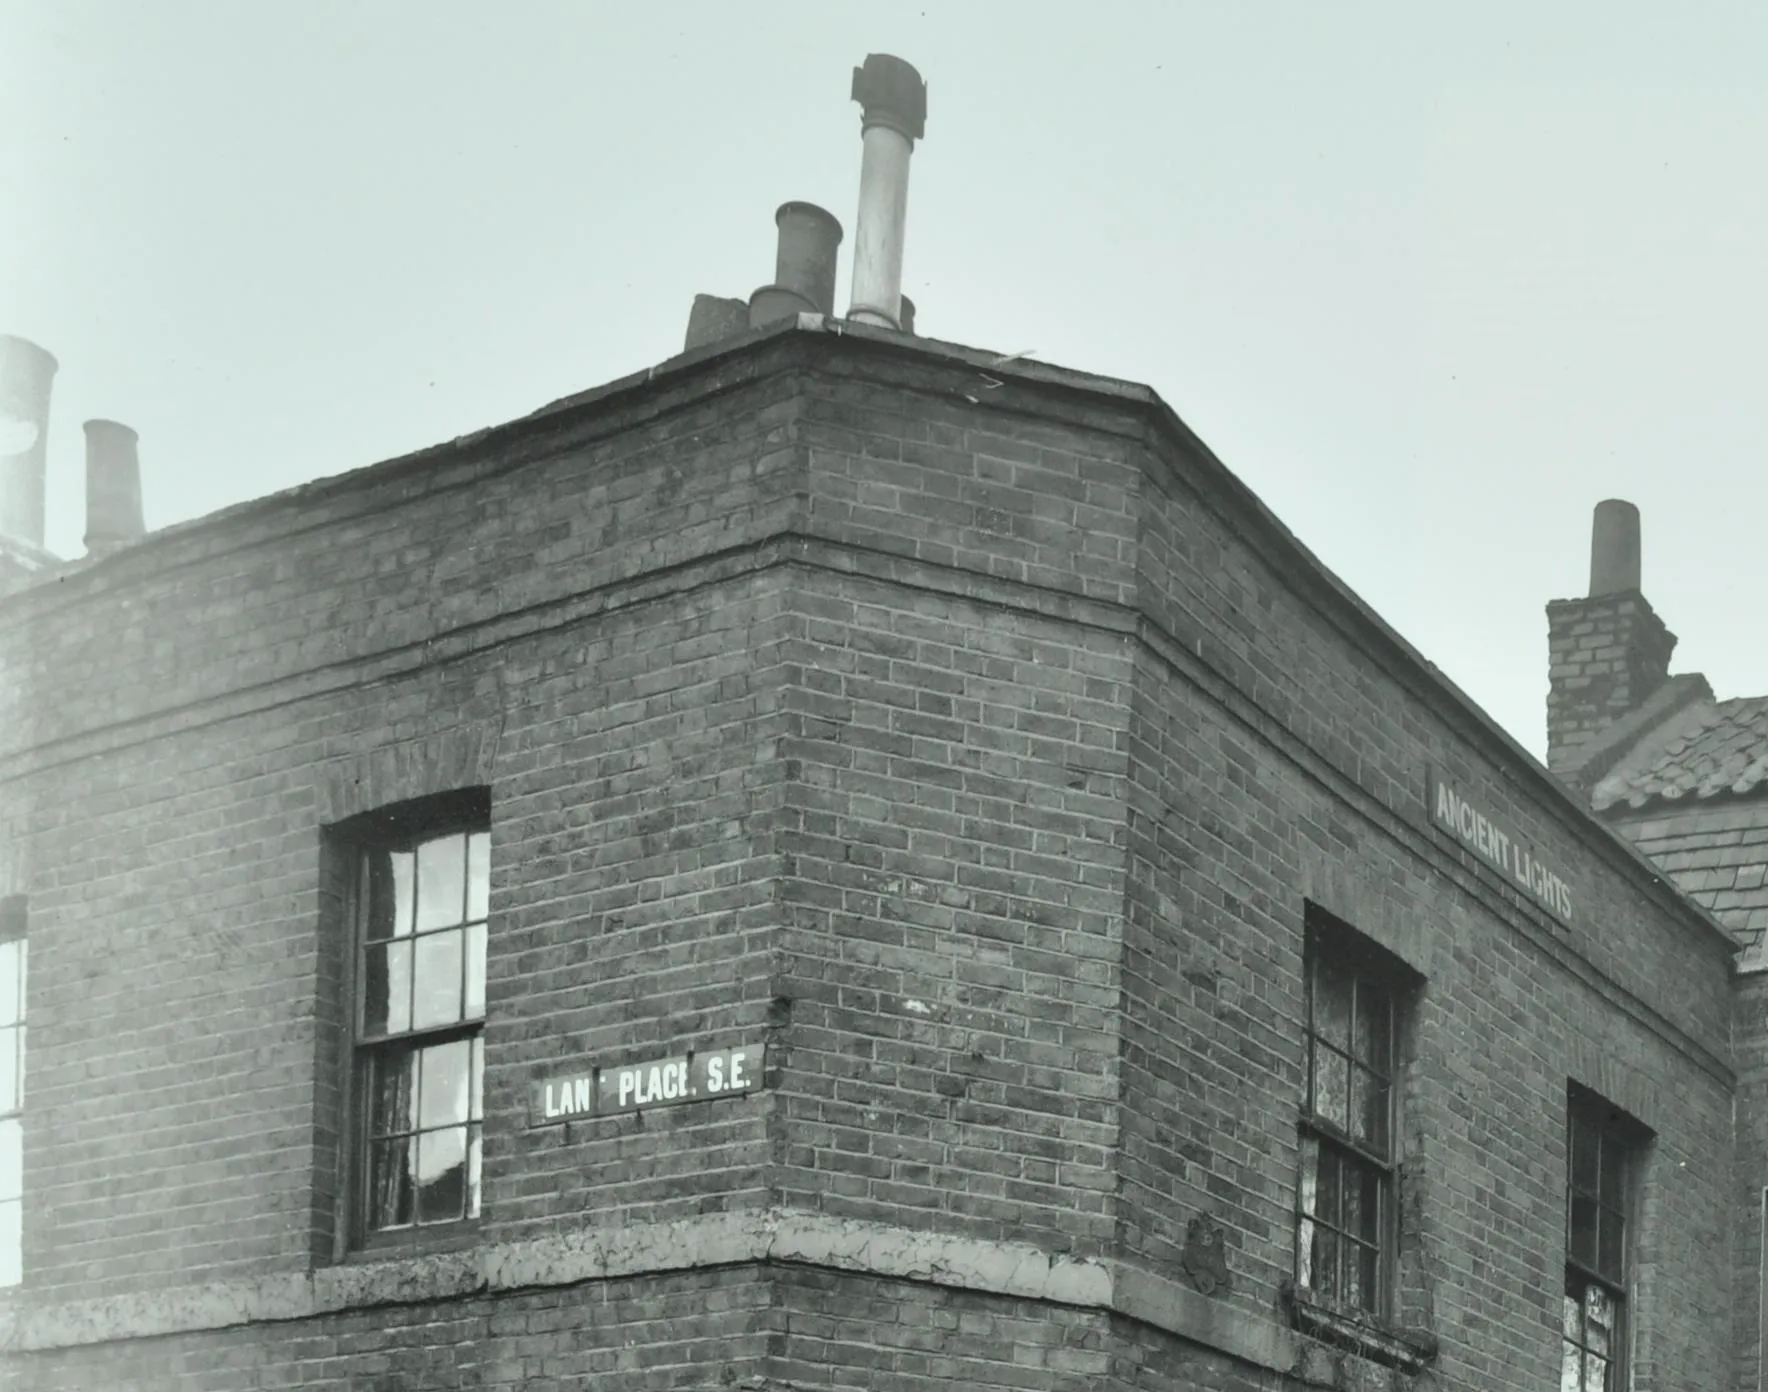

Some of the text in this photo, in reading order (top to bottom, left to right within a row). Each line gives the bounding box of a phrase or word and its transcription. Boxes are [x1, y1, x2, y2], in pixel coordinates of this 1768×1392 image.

[1437, 782, 1572, 920] ANCIENT LIGHTS
[545, 1072, 607, 1118] LAN
[707, 1052, 751, 1092] S.E.
